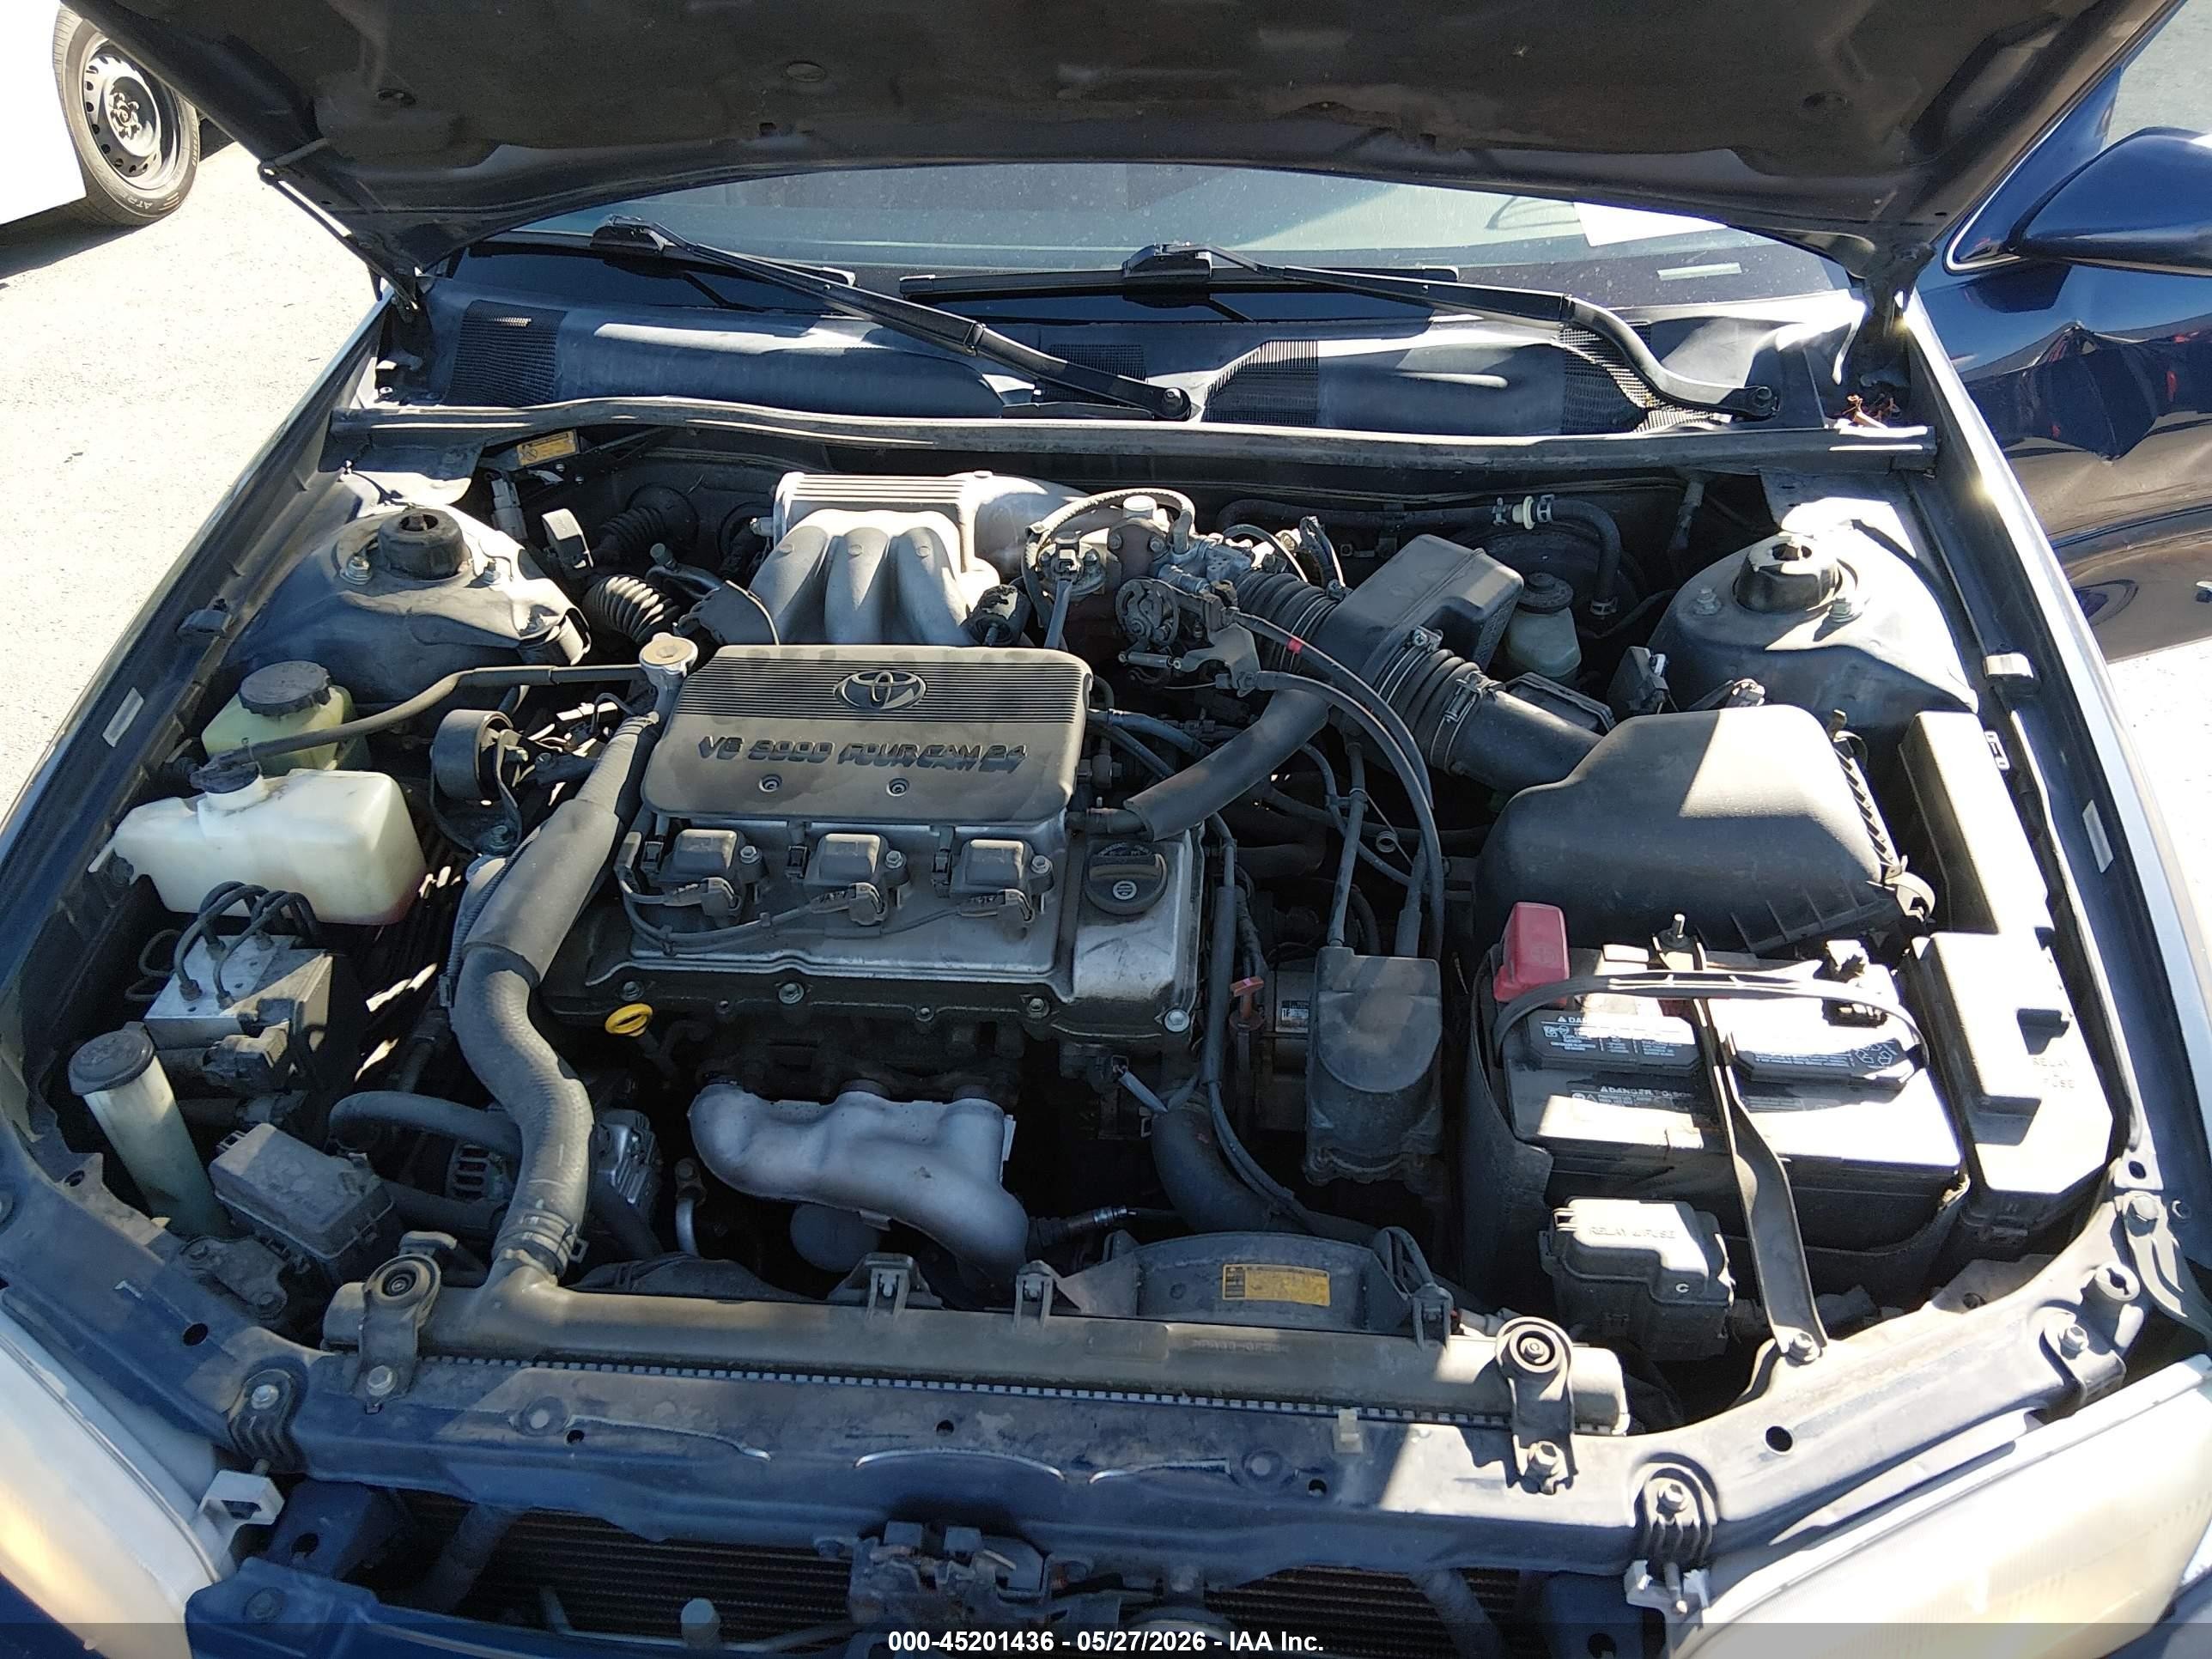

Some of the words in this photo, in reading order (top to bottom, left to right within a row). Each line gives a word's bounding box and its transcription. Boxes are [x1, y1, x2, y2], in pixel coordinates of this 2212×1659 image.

[698, 735, 744, 759] V6
[748, 738, 835, 763] 3000
[837, 742, 920, 768] FOUR
[916, 743, 982, 771] CAM
[979, 744, 1028, 774] 24
